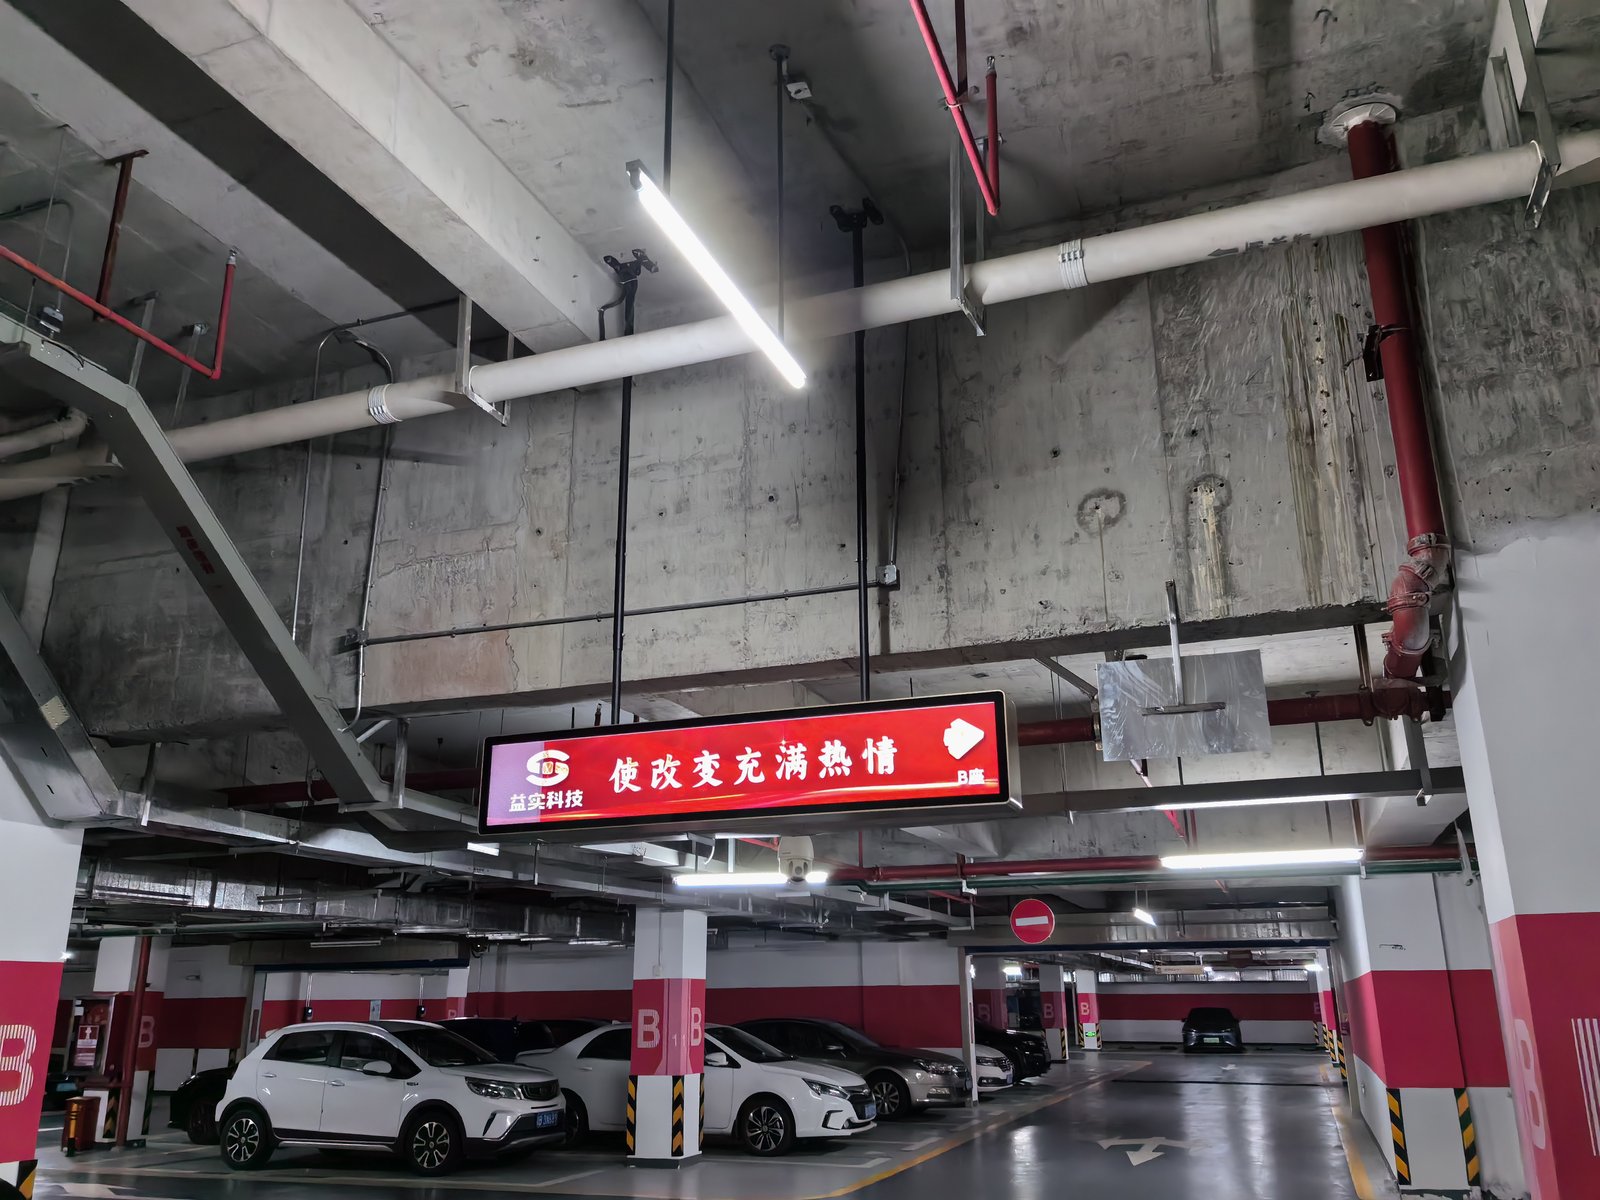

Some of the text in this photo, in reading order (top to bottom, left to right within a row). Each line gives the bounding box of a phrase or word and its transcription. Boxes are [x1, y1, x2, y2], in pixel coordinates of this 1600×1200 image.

[609, 736, 898, 793] 使改变充满热情
[509, 789, 583, 812] 益实科技
[637, 1009, 660, 1049] B
[690, 1007, 702, 1047] B
[0, 1024, 37, 1106] B
